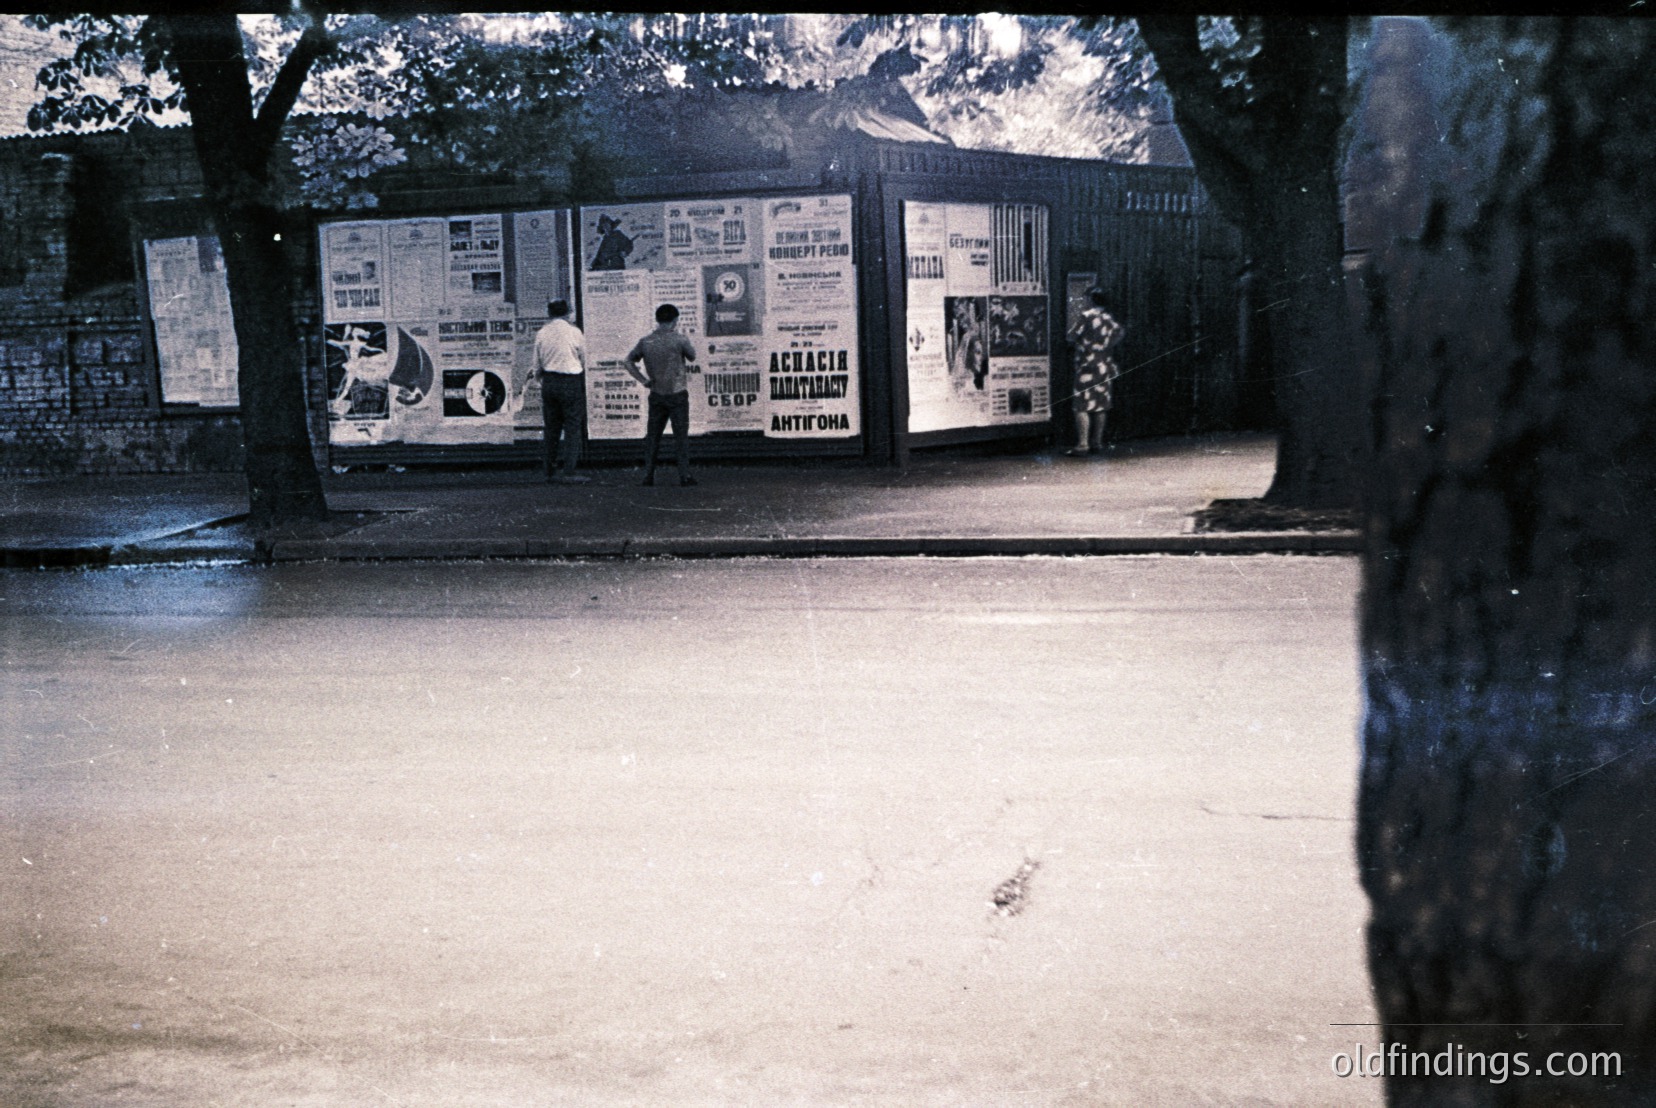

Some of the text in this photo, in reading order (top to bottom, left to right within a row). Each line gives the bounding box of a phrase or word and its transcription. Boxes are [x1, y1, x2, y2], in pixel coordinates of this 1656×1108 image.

[769, 242, 849, 260] КОНЦЕРТ РЕВЮ
[723, 279, 737, 292] 50
[769, 350, 848, 373] АСПАСІЯ
[707, 393, 757, 407] СБОР
[771, 413, 850, 431] АНТІГОНА
